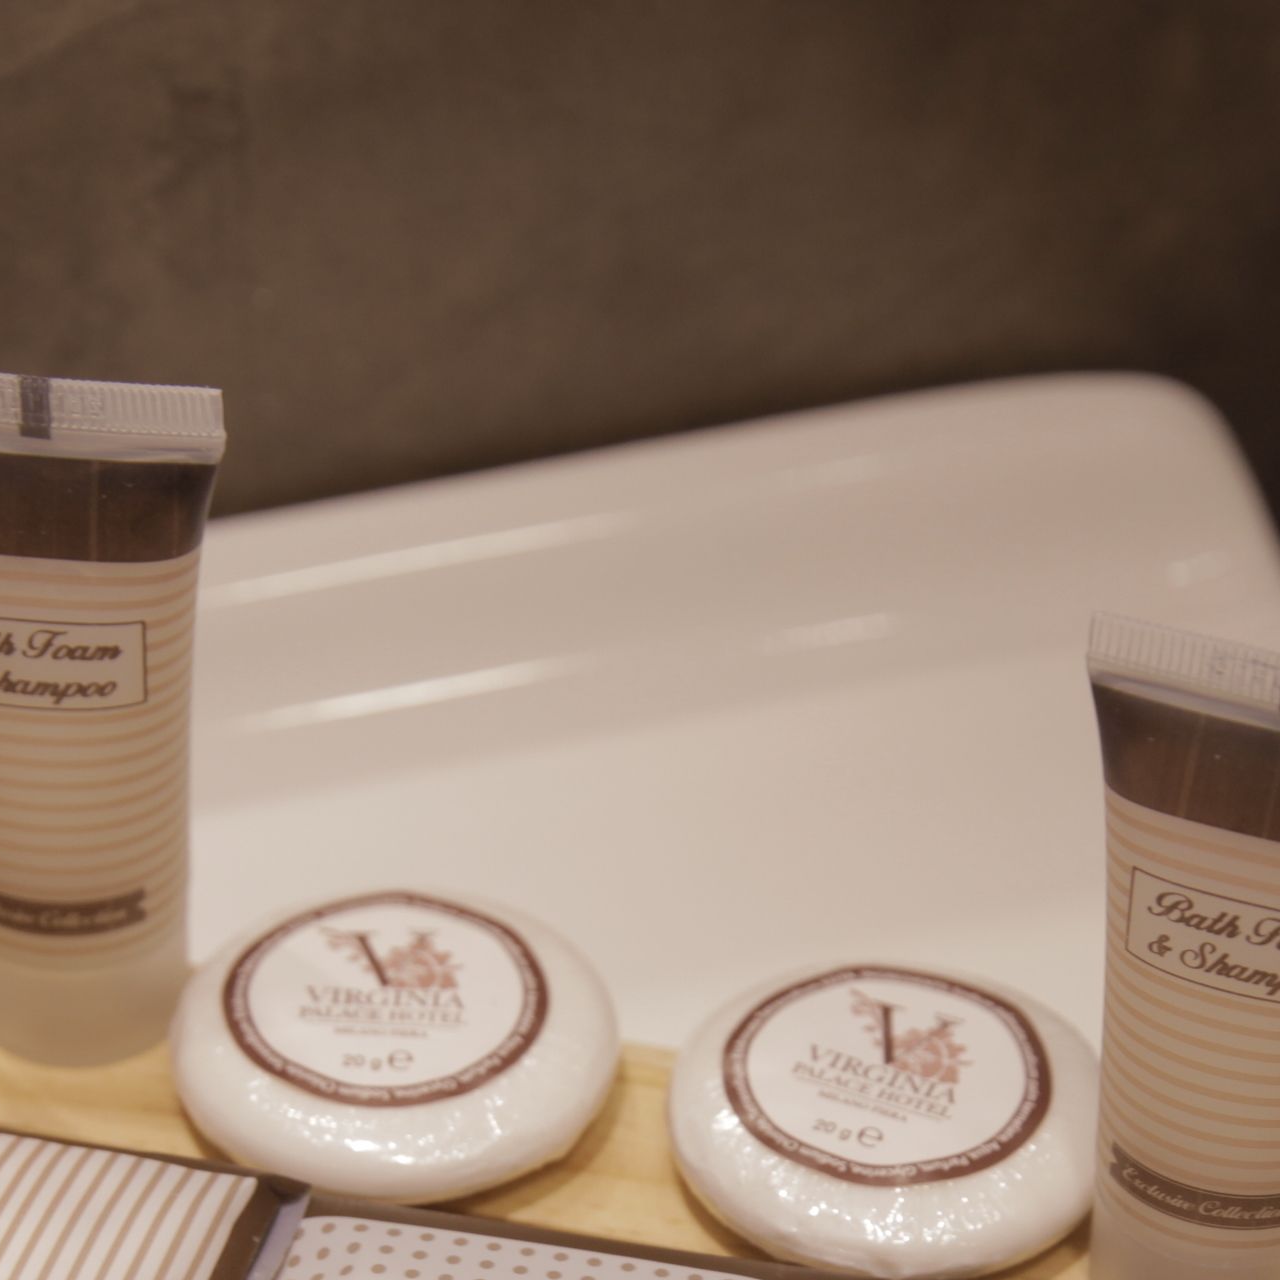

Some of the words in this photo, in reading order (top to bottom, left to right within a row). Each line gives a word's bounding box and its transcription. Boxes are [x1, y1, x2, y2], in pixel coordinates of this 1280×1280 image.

[22, 629, 122, 661] Foam
[1147, 892, 1241, 939] Bath
[1148, 934, 1173, 957] &
[306, 985, 464, 1009] VIRGINIA
[792, 1061, 870, 1094] PALACE
[877, 1088, 953, 1120] HOTEL
[811, 1043, 955, 1104] VIRGINIA
